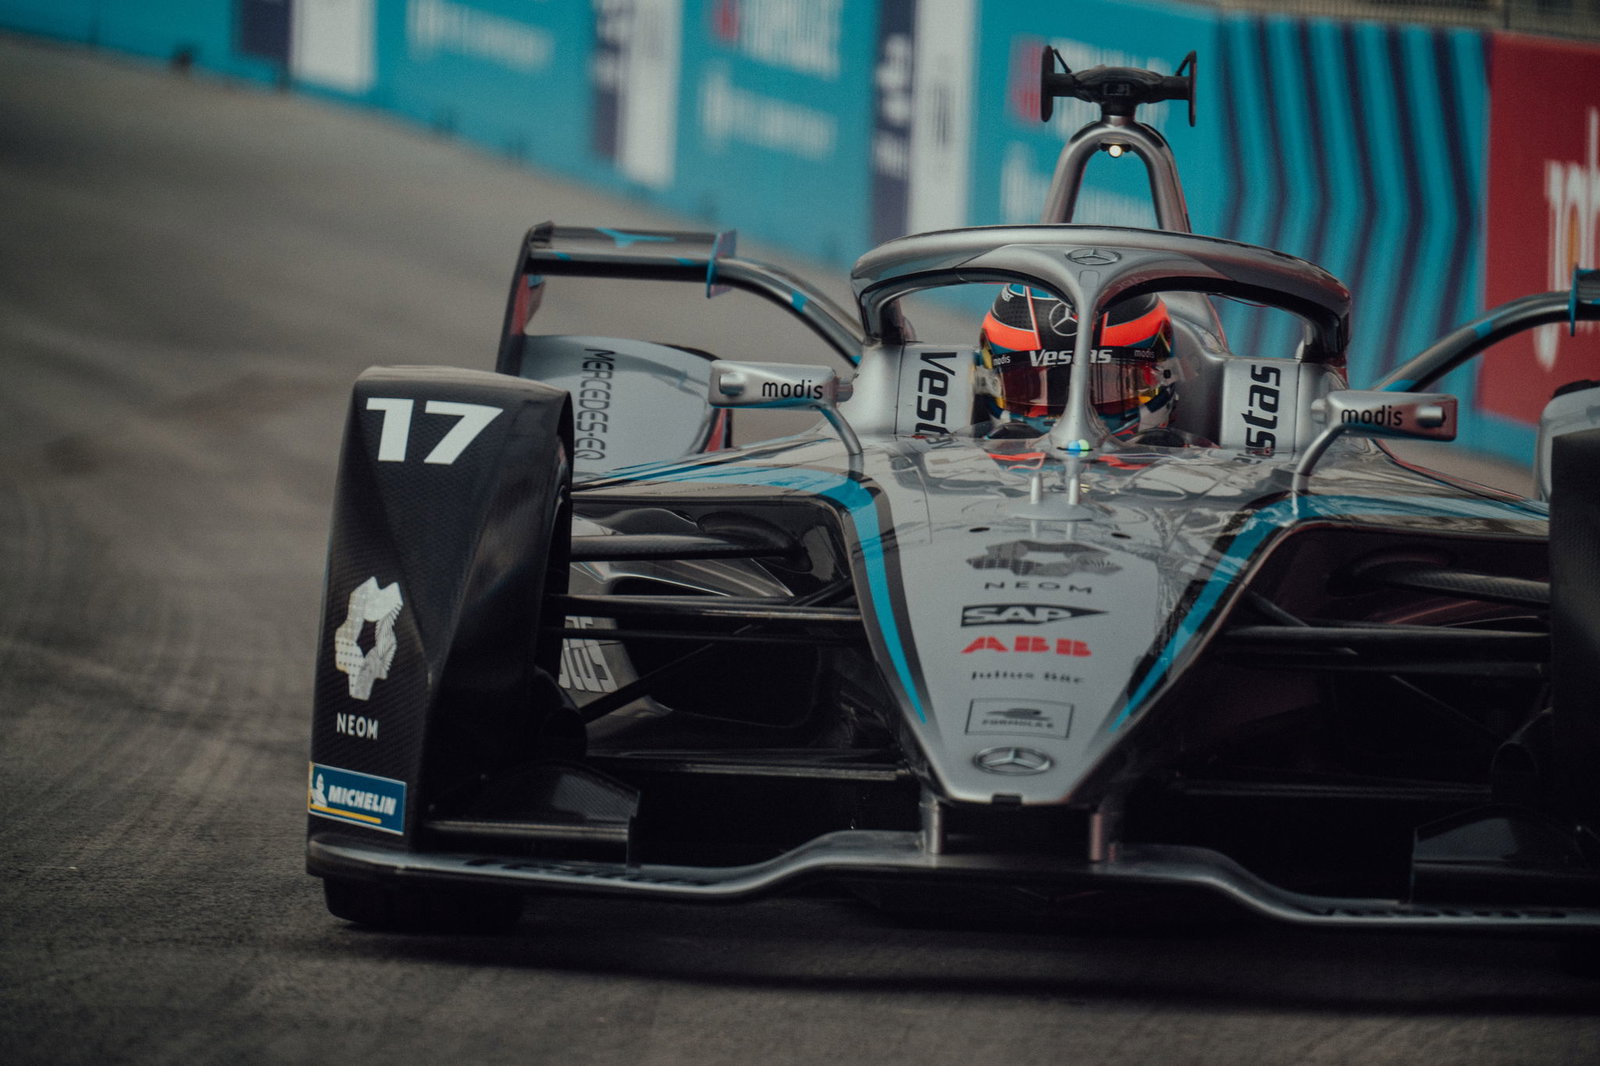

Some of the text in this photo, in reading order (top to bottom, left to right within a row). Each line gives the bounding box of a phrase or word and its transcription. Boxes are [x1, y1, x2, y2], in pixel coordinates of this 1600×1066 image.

[1029, 349, 1113, 367] Vesas
[761, 379, 824, 400] modis
[1341, 405, 1403, 427] modis
[366, 397, 504, 466] 17
[984, 581, 1093, 595] NEOM
[961, 604, 1075, 625] SAP
[961, 636, 1092, 657] ABB
[337, 712, 379, 740] NEOM
[328, 785, 397, 816] MICHELIN
